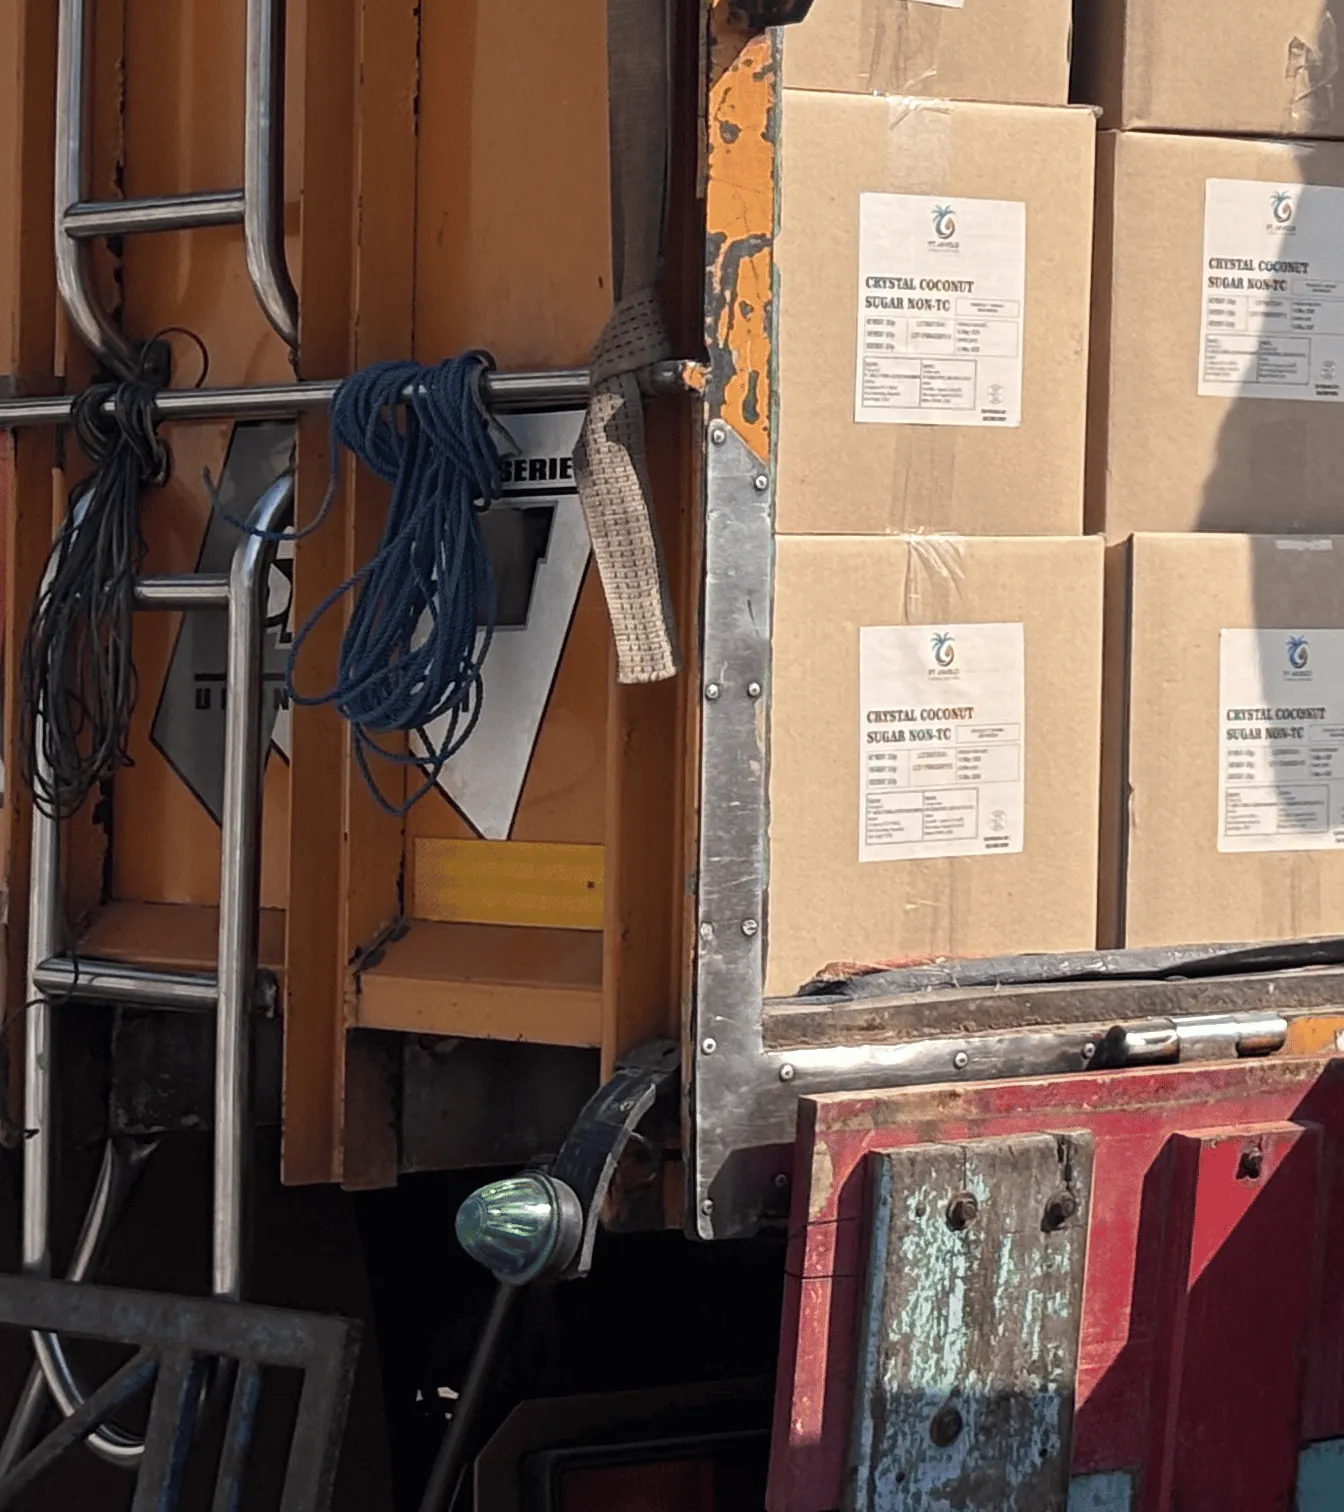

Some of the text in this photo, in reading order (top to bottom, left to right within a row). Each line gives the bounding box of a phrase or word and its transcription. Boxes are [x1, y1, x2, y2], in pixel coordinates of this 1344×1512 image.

[1208, 257, 1309, 274] CRYSTAL COCONUT
[865, 276, 975, 294] CRYSTAL COCONUT
[1208, 276, 1287, 292] SUGAR NON-TC
[865, 296, 951, 312] SUGAR NON-TC
[500, 456, 574, 483] SERIE
[866, 706, 974, 724] CRYSTAL COCONUT
[1226, 707, 1326, 722] CRYSTAL COCONUT
[866, 727, 951, 744] SUGAR NON-TC
[1226, 726, 1304, 741] SUGAR NON-TC
